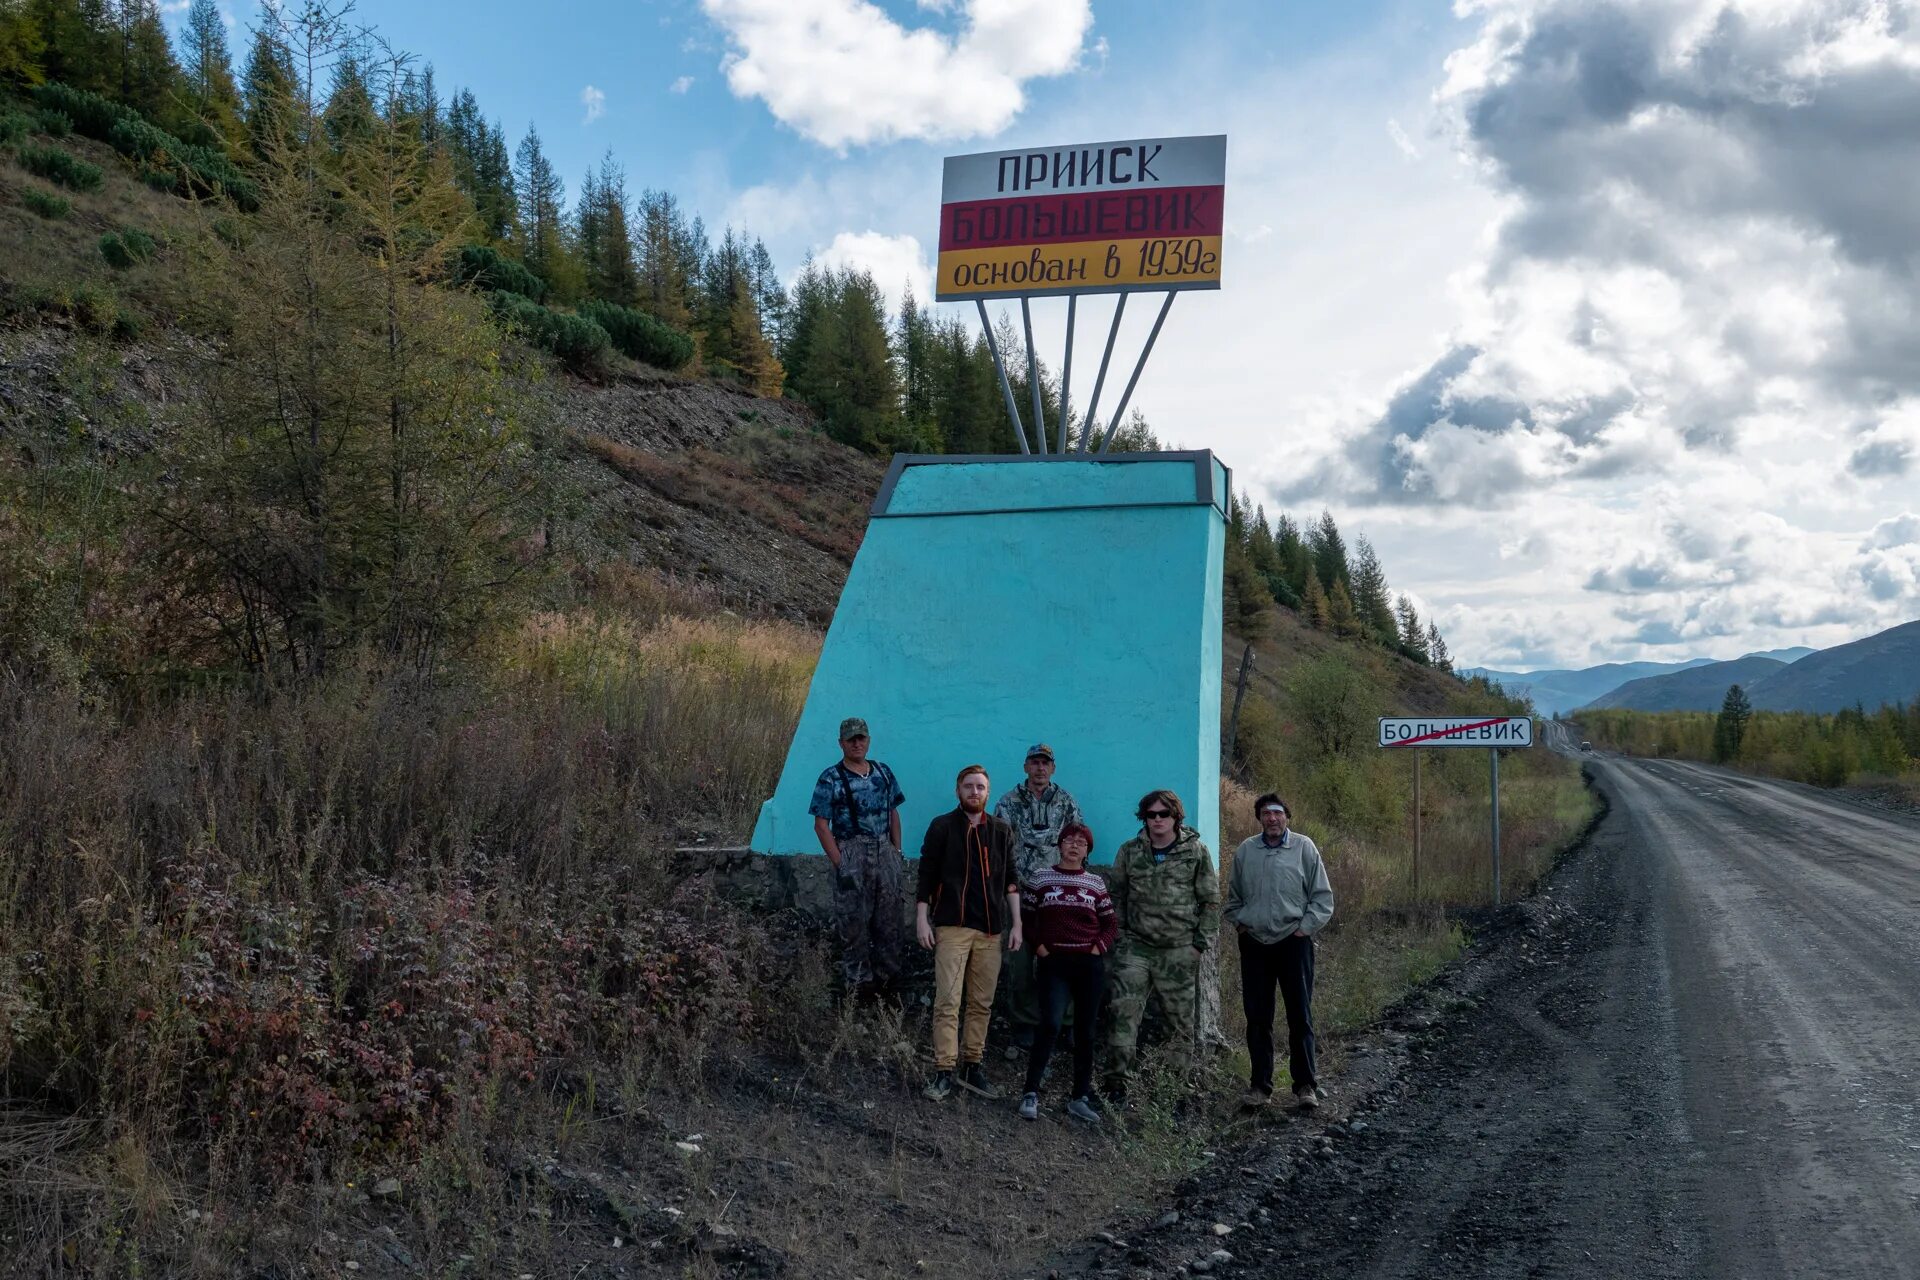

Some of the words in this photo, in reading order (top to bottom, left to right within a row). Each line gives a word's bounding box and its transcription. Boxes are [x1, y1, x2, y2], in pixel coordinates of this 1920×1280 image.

[998, 145, 1163, 192] ПРИИСК
[952, 192, 1208, 243] БОЛЬШЕВИК
[954, 248, 1087, 286] основан
[1104, 245, 1121, 278] в
[1384, 723, 1525, 740] БОЛЬШЕВИК
